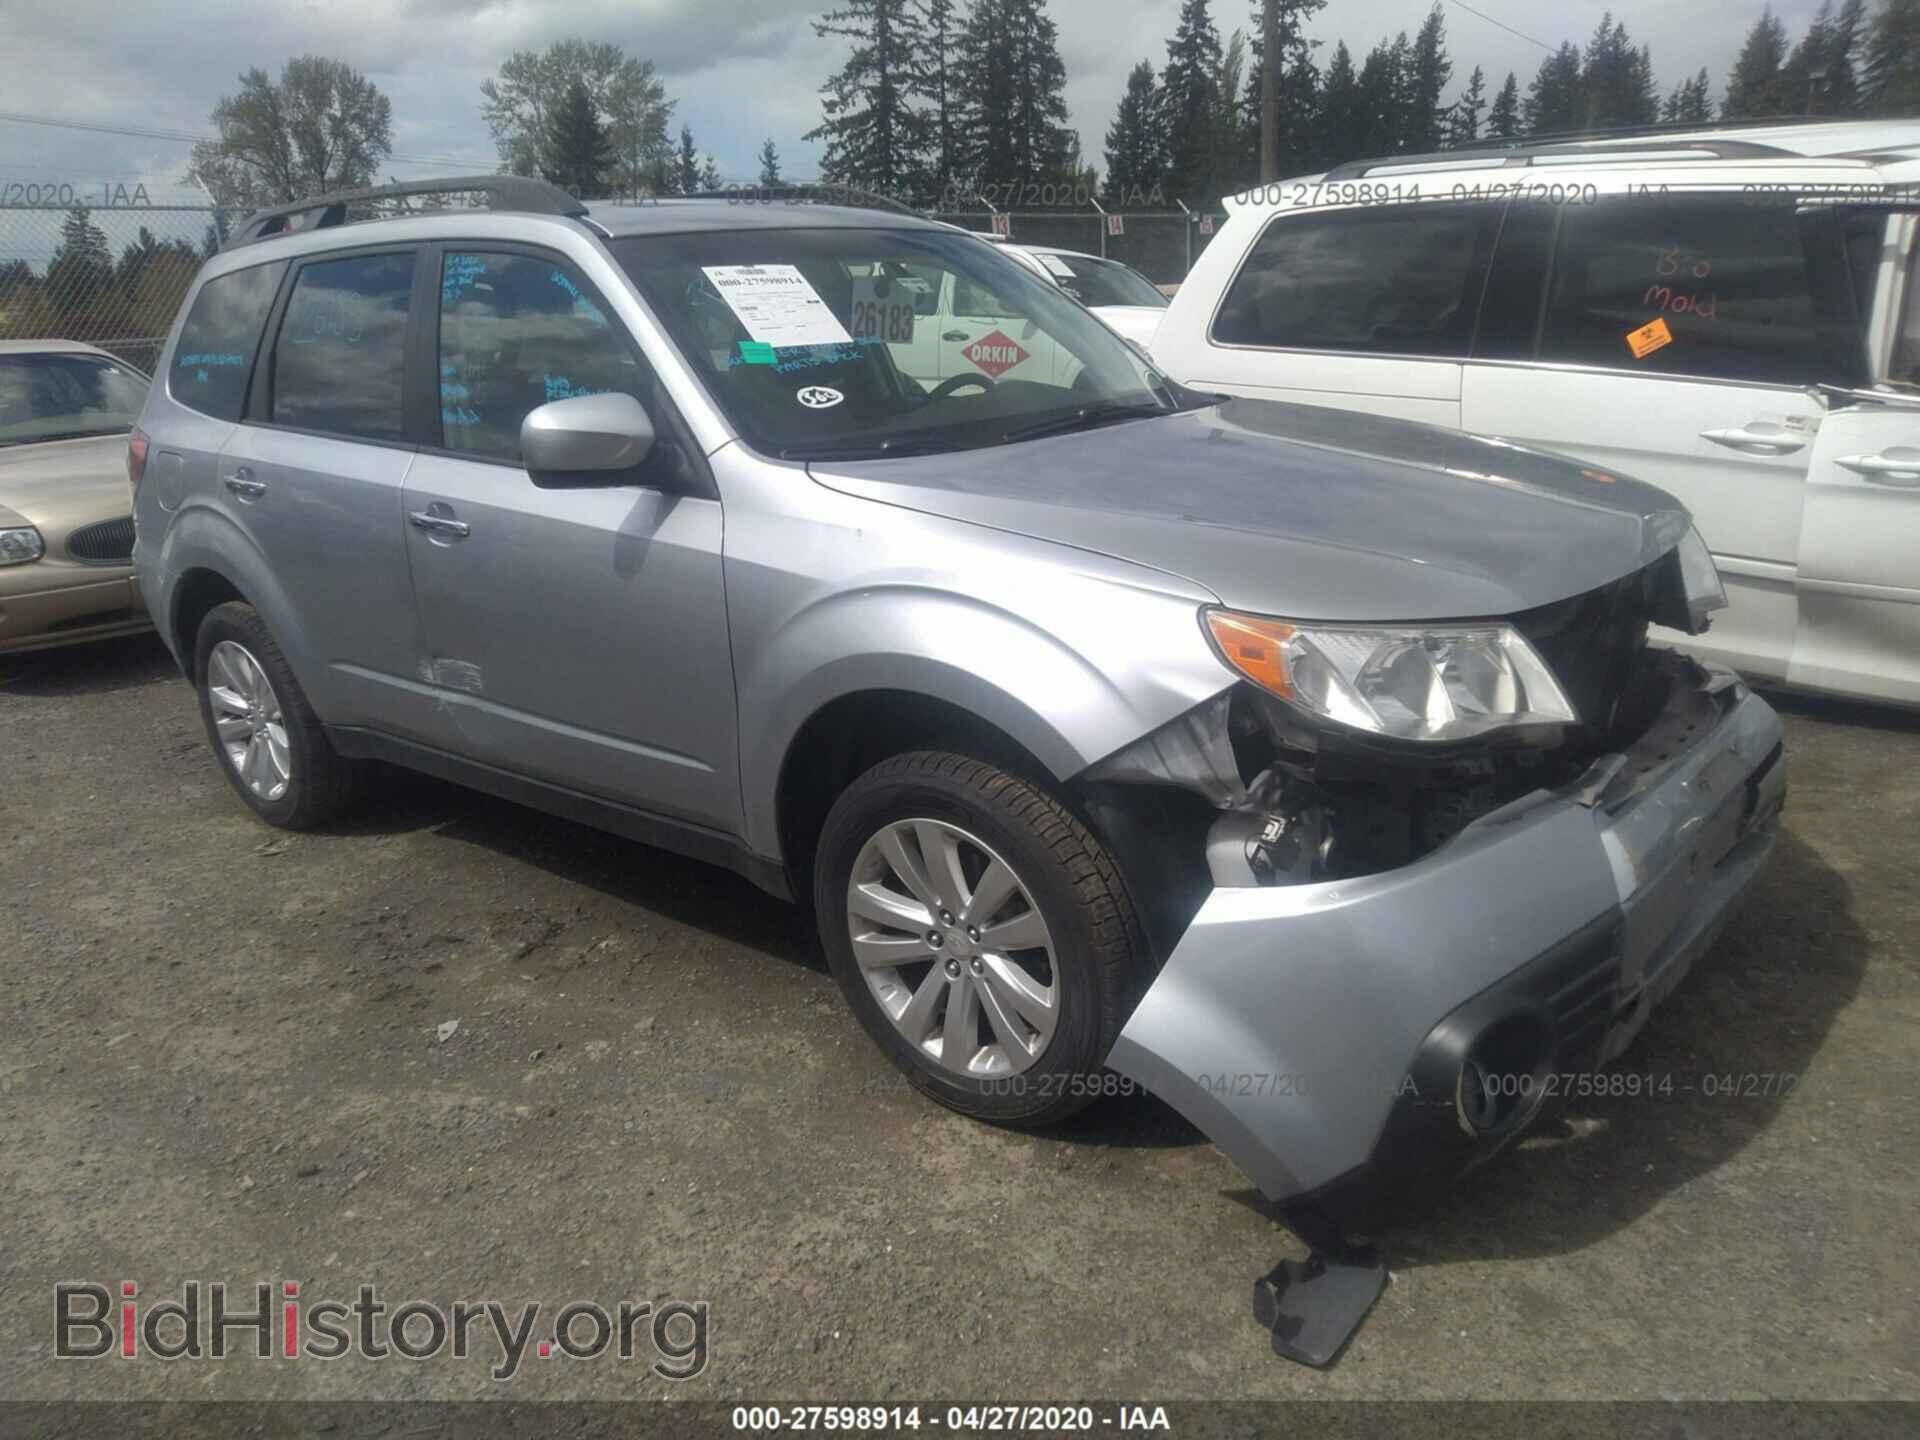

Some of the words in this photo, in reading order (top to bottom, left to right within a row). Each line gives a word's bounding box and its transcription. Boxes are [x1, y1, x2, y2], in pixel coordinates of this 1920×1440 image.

[993, 216, 1008, 234] 13
[853, 301, 913, 341] 26183
[971, 344, 1018, 363] ORKIN
